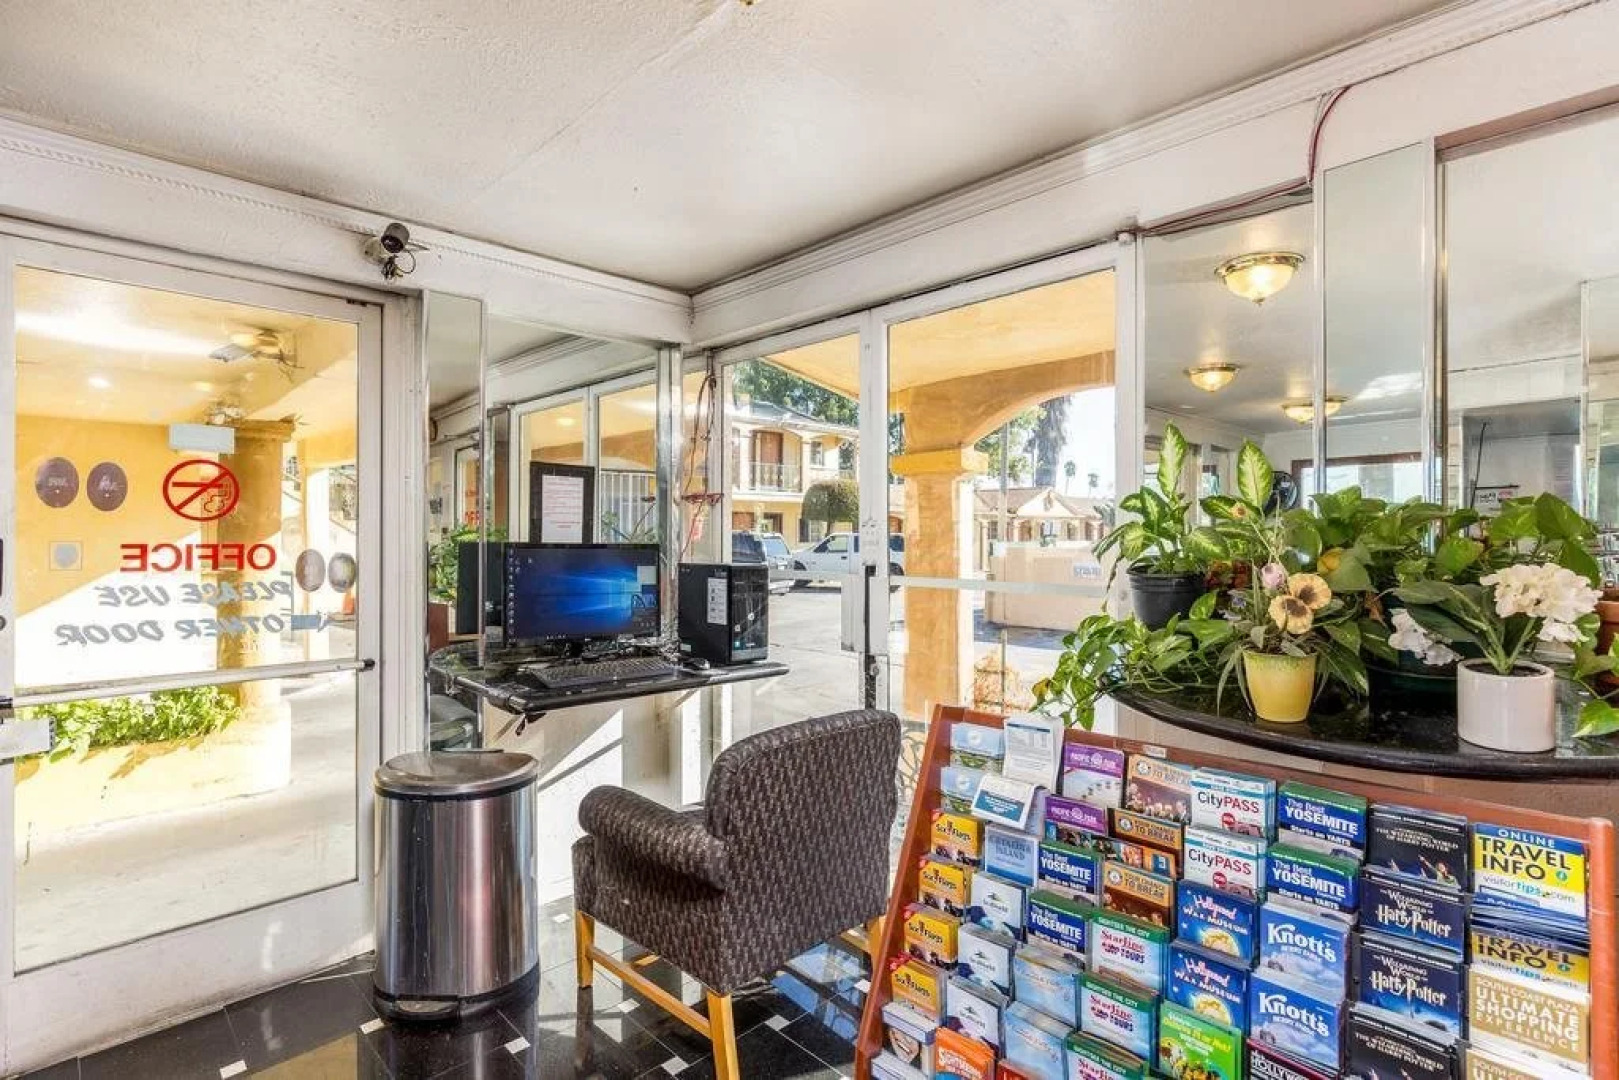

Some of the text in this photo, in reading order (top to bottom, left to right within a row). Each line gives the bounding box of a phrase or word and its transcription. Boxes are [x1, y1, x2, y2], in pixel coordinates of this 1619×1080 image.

[1197, 791, 1260, 813] CityPASS
[1287, 798, 1303, 809] The
[1285, 806, 1359, 836] YOSEMITE
[1498, 828, 1555, 848] ONLINE
[1041, 857, 1092, 880] YOSEMITE
[1188, 849, 1251, 875] CityPASS
[1275, 859, 1291, 871] The
[1479, 836, 1571, 871] TRAVEL
[1481, 854, 1546, 880] INFO
[1272, 868, 1346, 899] YOSEMITE
[1031, 911, 1083, 940] YOSEMITE
[1378, 904, 1452, 937] Harry Potter
[1267, 923, 1337, 963] Knott's
[1479, 943, 1547, 970] INFO
[1371, 970, 1447, 1007] Harry Potter
[1259, 992, 1329, 1037] Knott's
[1476, 986, 1579, 1027] ULTIMATE
[1476, 999, 1579, 1042] SHOPPING
[1476, 1011, 1579, 1052] EXPERIENCE
